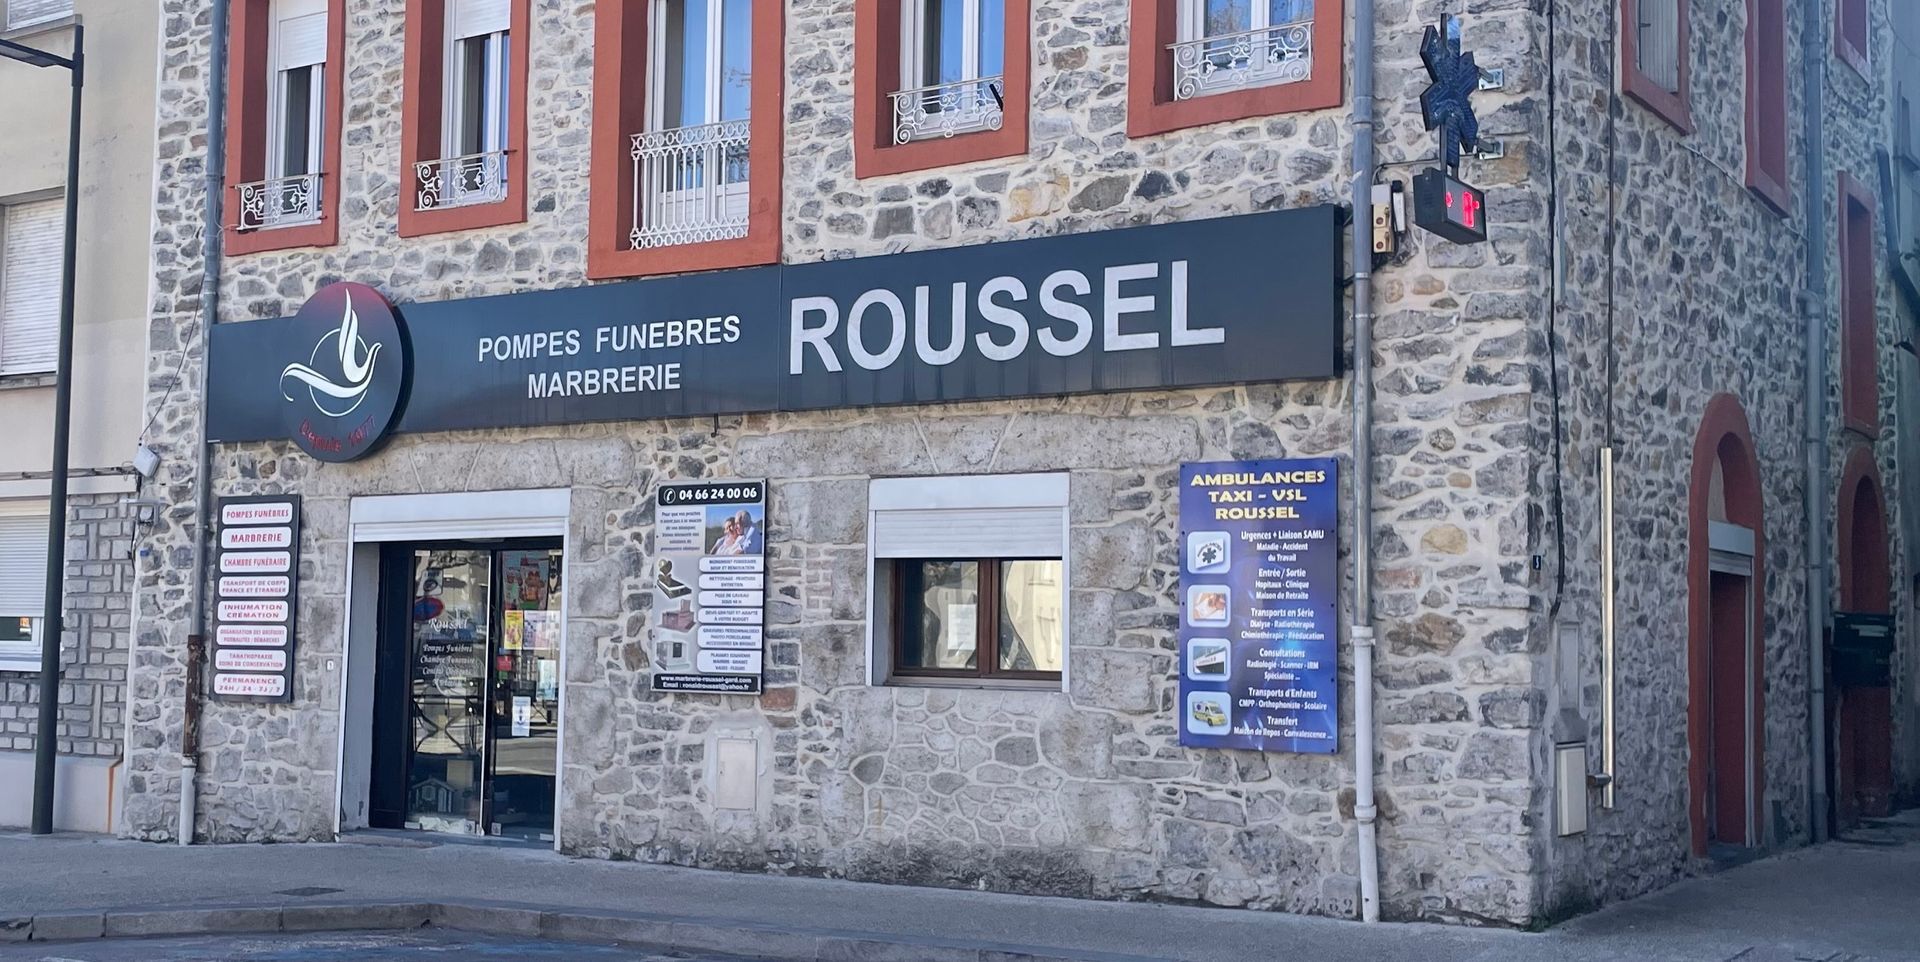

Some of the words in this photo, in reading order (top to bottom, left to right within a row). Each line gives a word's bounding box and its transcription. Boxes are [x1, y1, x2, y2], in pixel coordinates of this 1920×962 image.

[789, 259, 1226, 375] ROUSSEL
[478, 329, 581, 362] POMPES
[596, 315, 741, 353] FUNEBRES
[528, 362, 682, 399] MARBRERIE
[1190, 470, 1326, 486] AMBULANCES
[679, 489, 693, 500] 04
[694, 489, 708, 500] 66
[710, 488, 725, 499] 24
[726, 487, 741, 499] 00
[742, 487, 757, 498] 06
[1208, 490, 1253, 503] TAXI
[1271, 489, 1307, 501] VSL
[226, 510, 253, 519] POMPES
[1215, 506, 1300, 520] ROUSSEL
[231, 533, 282, 543] MARBRERIE
[1241, 531, 1271, 542] Urgences
[1278, 530, 1302, 539] Liaison
[1304, 530, 1324, 539] SAMU
[1283, 542, 1308, 550] Accident
[224, 558, 252, 567] CHAMBRE
[1268, 554, 1276, 562] du
[1277, 554, 1296, 562] Travail
[1258, 568, 1280, 578] Entrée
[1286, 568, 1306, 578] Sortie
[1286, 580, 1310, 589] Clinique
[1250, 608, 1286, 618] Transports
[1297, 608, 1314, 617] Série
[1250, 620, 1270, 630] Dialyse
[1274, 620, 1315, 630] Radiothérapie
[1241, 630, 1284, 640] Chimiothérapie
[1260, 648, 1306, 658] Consultations
[1246, 660, 1276, 670] Radiologie
[1280, 661, 1304, 669] Scanner
[1307, 661, 1318, 670] IRM
[1248, 688, 1284, 698] Transports
[1285, 688, 1317, 698] d'Enfants
[1239, 699, 1255, 708] CMPP
[1258, 700, 1300, 710] Orthophoniste
[1304, 701, 1328, 710] Scolaire
[1267, 716, 1298, 726] Transfert
[1234, 727, 1254, 735] Maison
[1255, 727, 1262, 735] de
[1263, 728, 1280, 738] Repos
[1284, 728, 1326, 738] Convalescence
